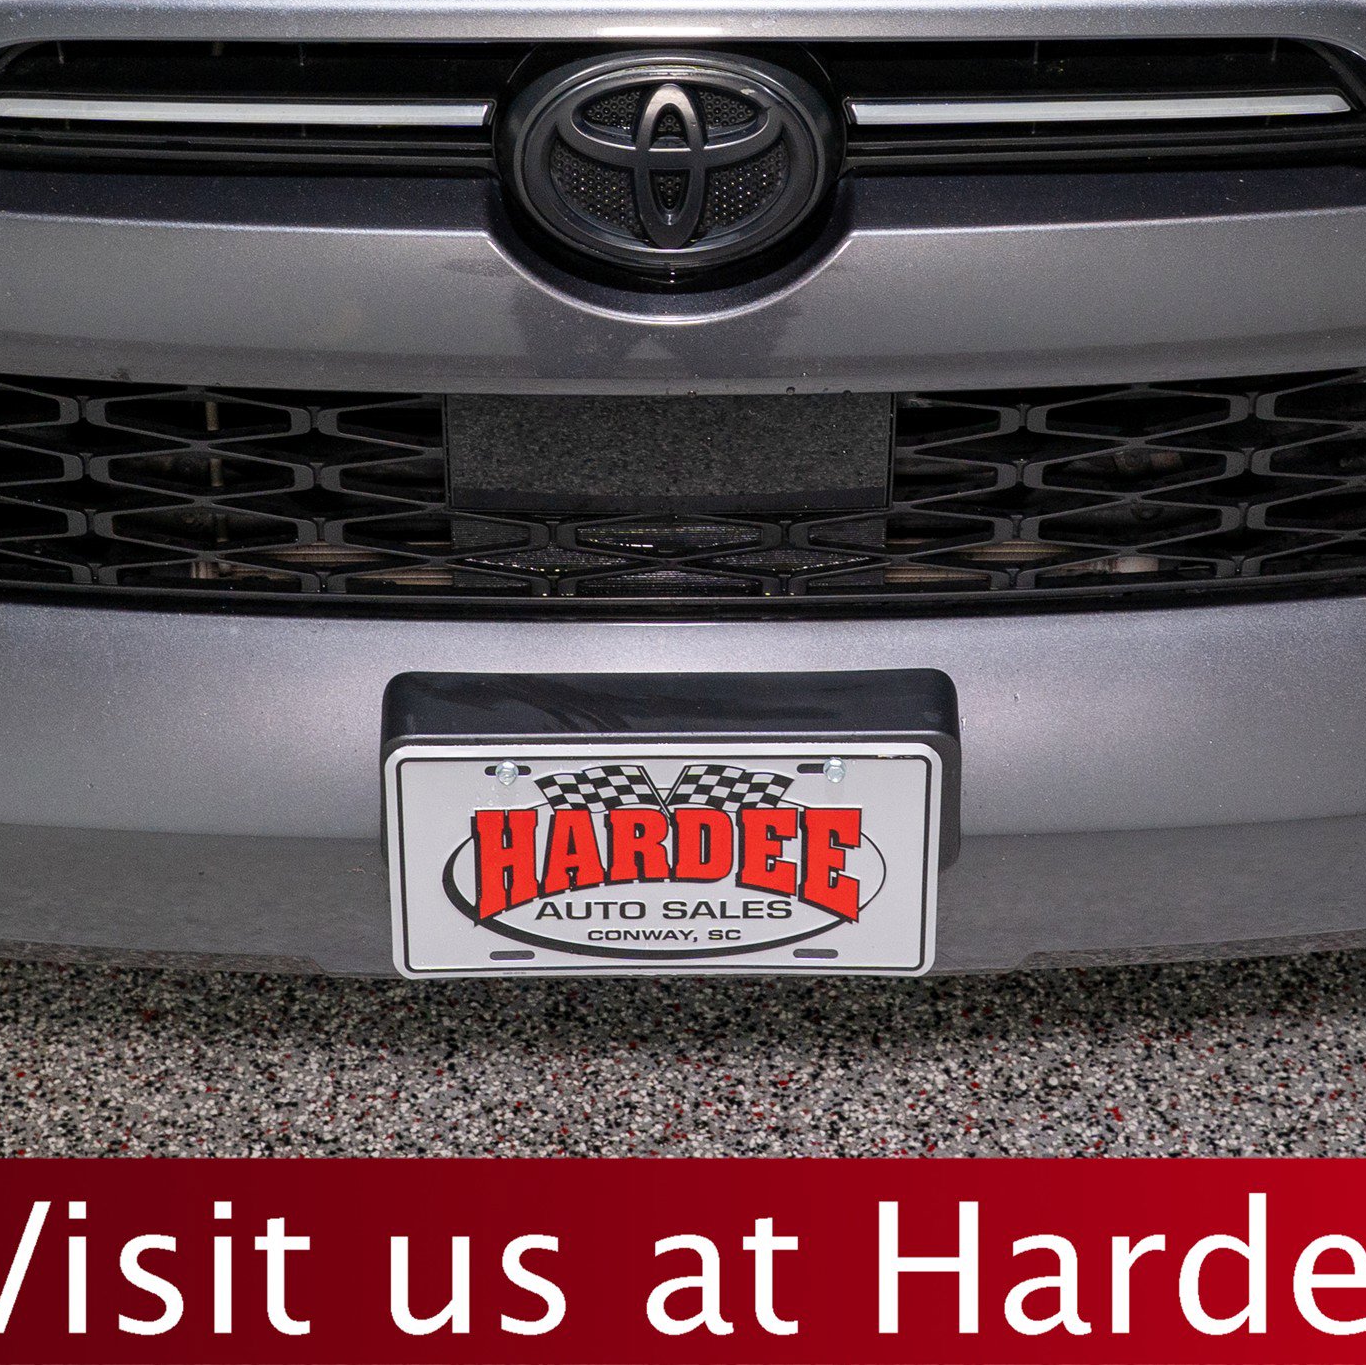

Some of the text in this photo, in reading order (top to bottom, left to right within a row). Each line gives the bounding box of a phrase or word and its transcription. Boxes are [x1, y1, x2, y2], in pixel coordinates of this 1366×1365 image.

[471, 807, 863, 926] HARDEE
[535, 900, 793, 921] AUTO SALES
[587, 929, 742, 942] CONWAY, SC
